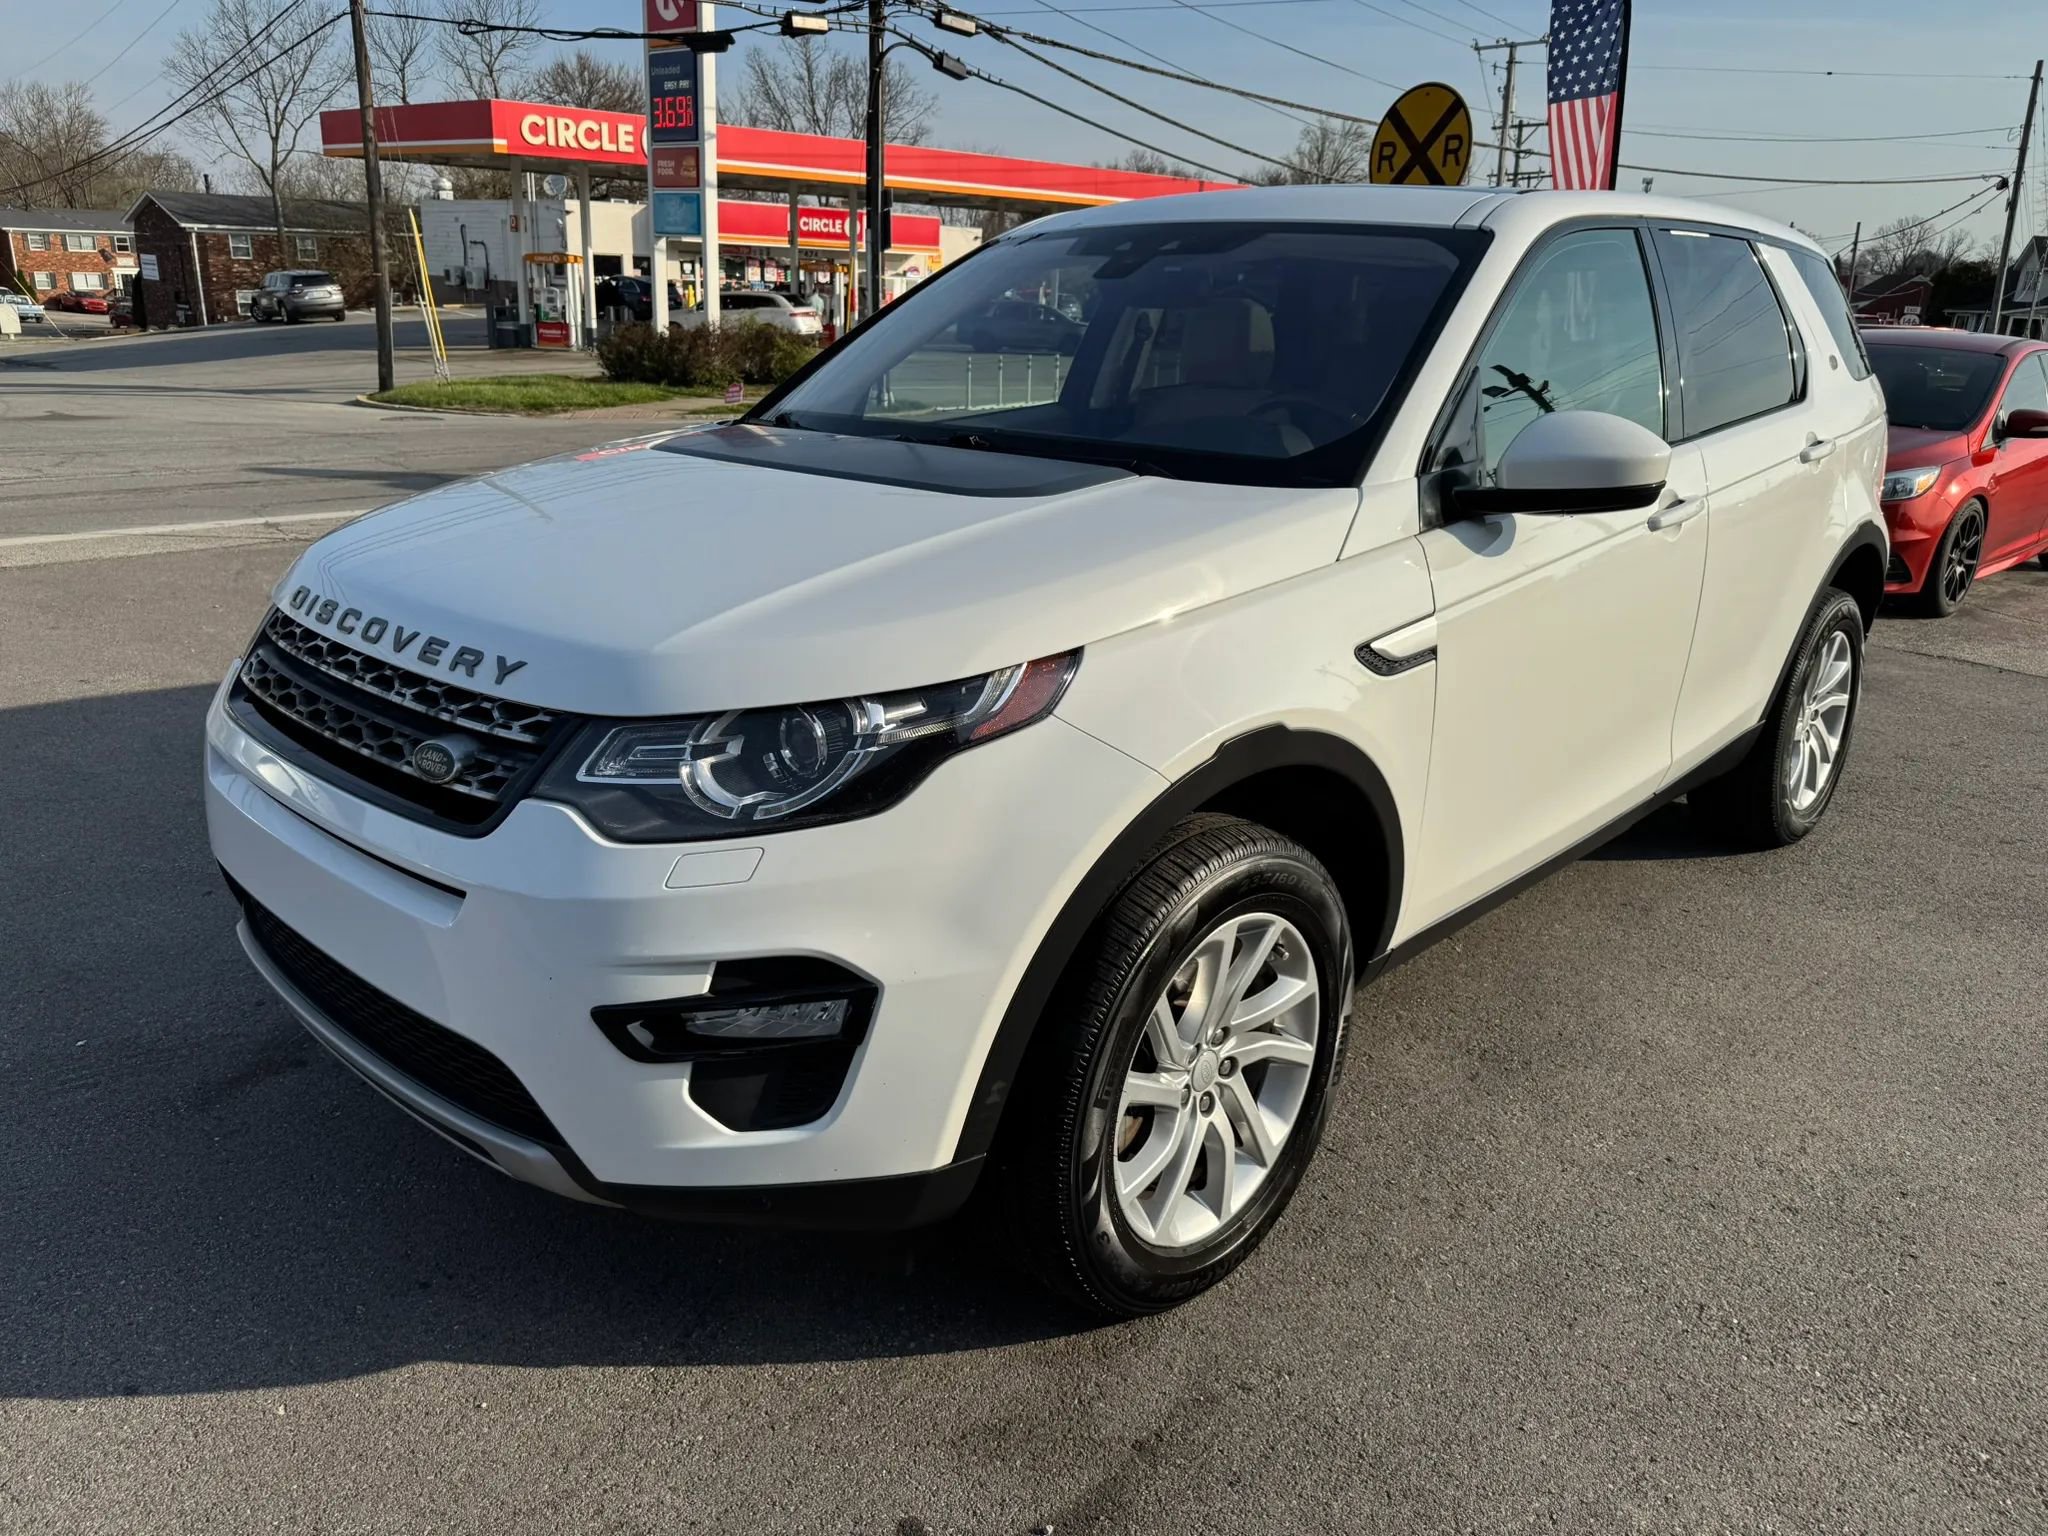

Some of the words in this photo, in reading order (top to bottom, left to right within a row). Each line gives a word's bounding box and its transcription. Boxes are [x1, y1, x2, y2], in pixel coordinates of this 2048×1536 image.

[521, 114, 635, 153] CIRCLE
[657, 160, 675, 168] FRESH
[799, 216, 843, 233] CIRCLE
[1903, 317, 1918, 326] 146
[289, 585, 528, 685] DISCOVERY
[421, 749, 443, 762] LAND
[421, 759, 448, 774] ROVER
